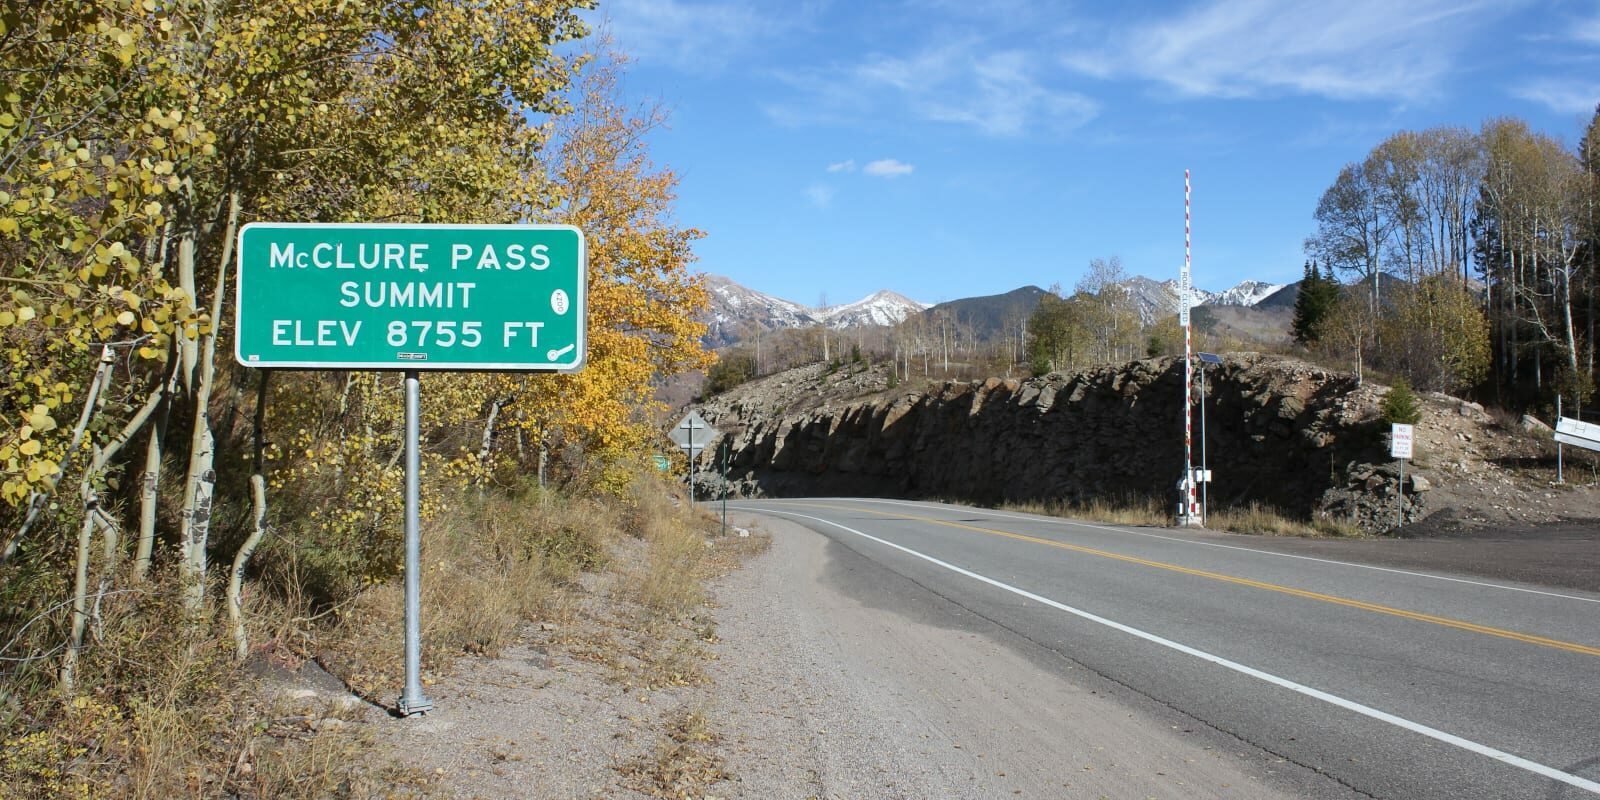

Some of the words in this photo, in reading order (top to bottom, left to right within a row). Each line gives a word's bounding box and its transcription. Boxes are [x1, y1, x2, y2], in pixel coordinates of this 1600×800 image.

[270, 242, 429, 270] McCLURE
[452, 243, 551, 270] PASS
[339, 281, 476, 308] SUMMIT
[272, 320, 362, 346] ELEV
[387, 321, 483, 348] 8755
[503, 322, 545, 348] FT
